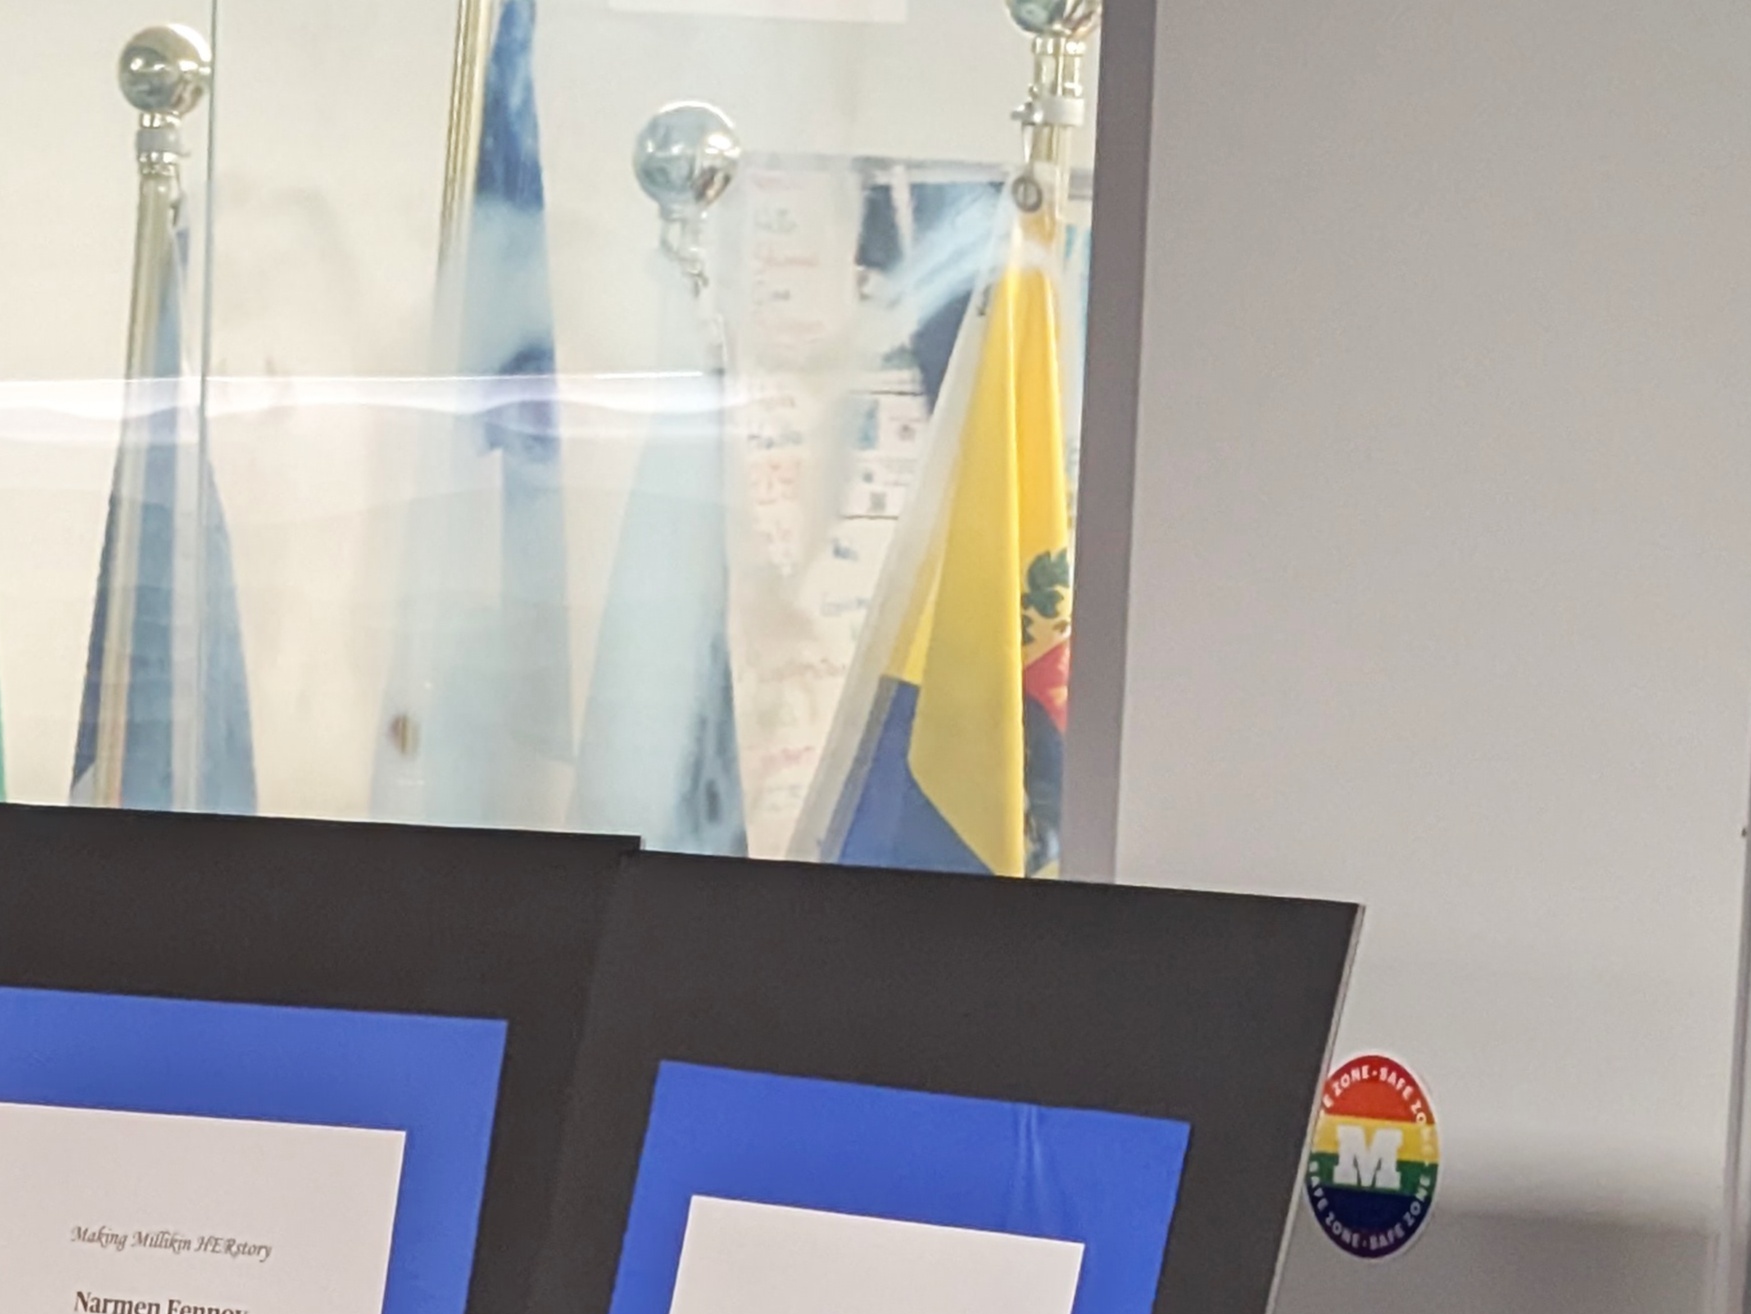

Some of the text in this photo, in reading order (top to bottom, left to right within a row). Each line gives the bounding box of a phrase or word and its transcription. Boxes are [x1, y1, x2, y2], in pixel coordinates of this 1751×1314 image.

[1333, 1065, 1414, 1099] ZONE SAFE
[1333, 1124, 1403, 1189] M
[70, 1225, 272, 1263] Making Millikin HERstory
[1370, 1225, 1405, 1250] SAFE
